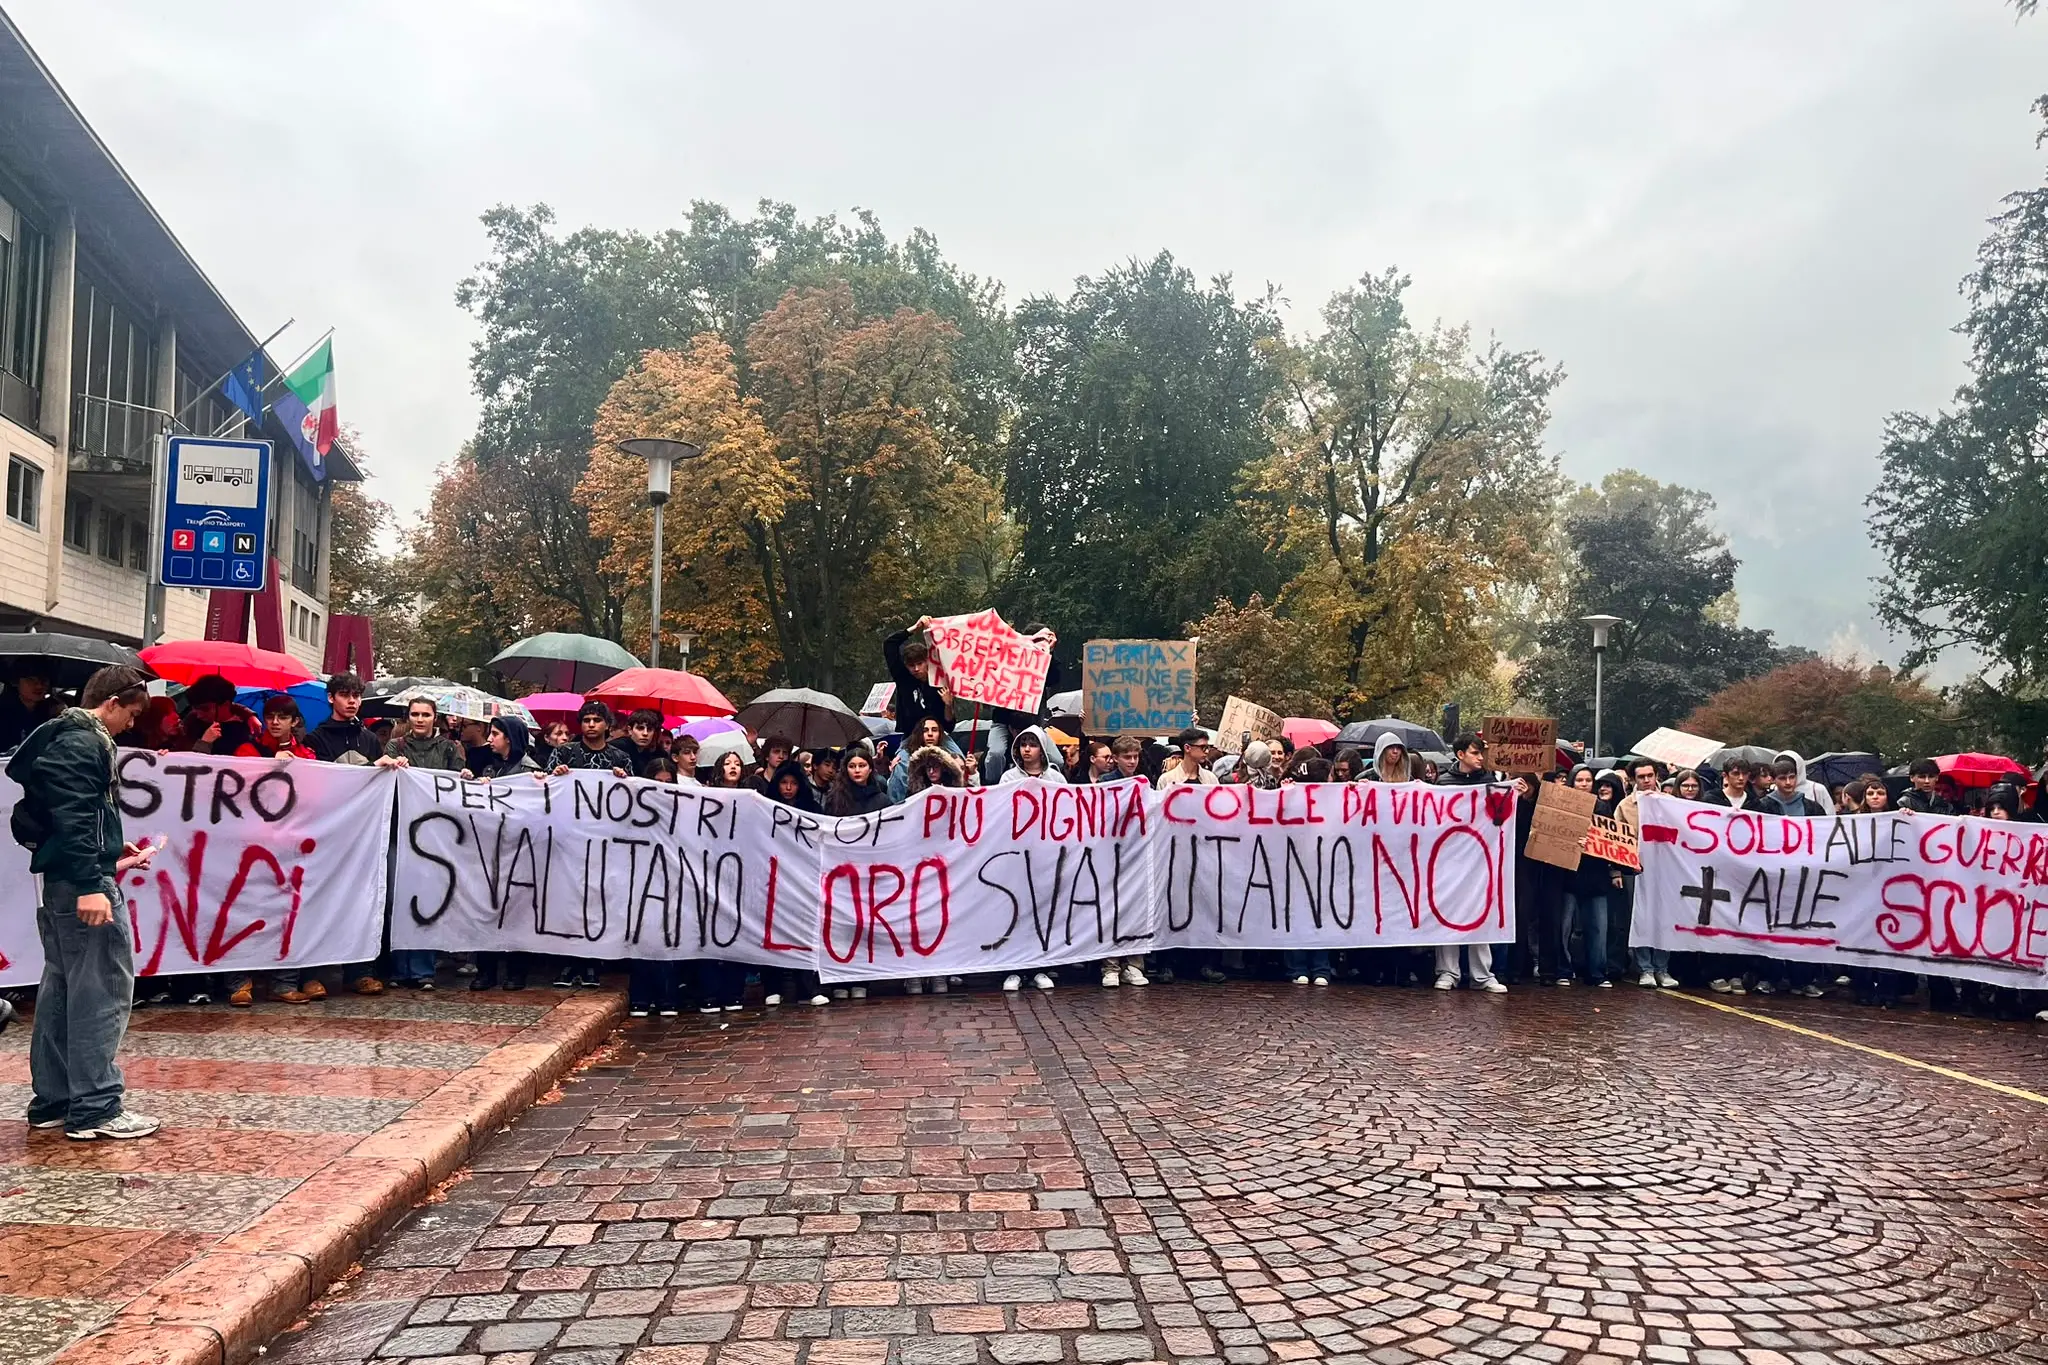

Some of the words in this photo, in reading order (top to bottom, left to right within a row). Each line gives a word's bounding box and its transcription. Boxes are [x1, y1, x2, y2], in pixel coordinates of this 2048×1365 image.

[216, 520, 246, 528] TRASPORTI
[178, 534, 188, 546] 2
[209, 536, 219, 548] 4
[238, 538, 250, 550] N
[930, 627, 1050, 674] OBBEDIENTI
[1169, 646, 1188, 662] X
[950, 654, 1044, 694] AVRETE
[1088, 668, 1171, 687] VETRINE
[1176, 668, 1192, 686] E
[934, 667, 1037, 714] MLEDUCATI
[1091, 688, 1130, 711] NON
[1145, 686, 1192, 706] PER
[1246, 705, 1285, 732] CULTURA
[116, 751, 296, 824] STRO
[434, 774, 513, 810] PER
[544, 782, 551, 814] I
[575, 778, 737, 840] NOSTRI
[772, 804, 905, 848] PROF
[1163, 783, 1325, 826] COLLE
[1342, 785, 1378, 827] DA
[1391, 787, 1478, 827] VINCI
[1603, 832, 1634, 846] SENZA
[1621, 823, 1637, 838] IL
[1682, 809, 1814, 856] SOLDI
[1825, 816, 1911, 866] ALLE
[1585, 836, 1639, 868] FUTURO
[409, 811, 744, 949] SVALUTANO
[763, 855, 951, 963] LORO
[1738, 866, 1848, 932] ALLE
